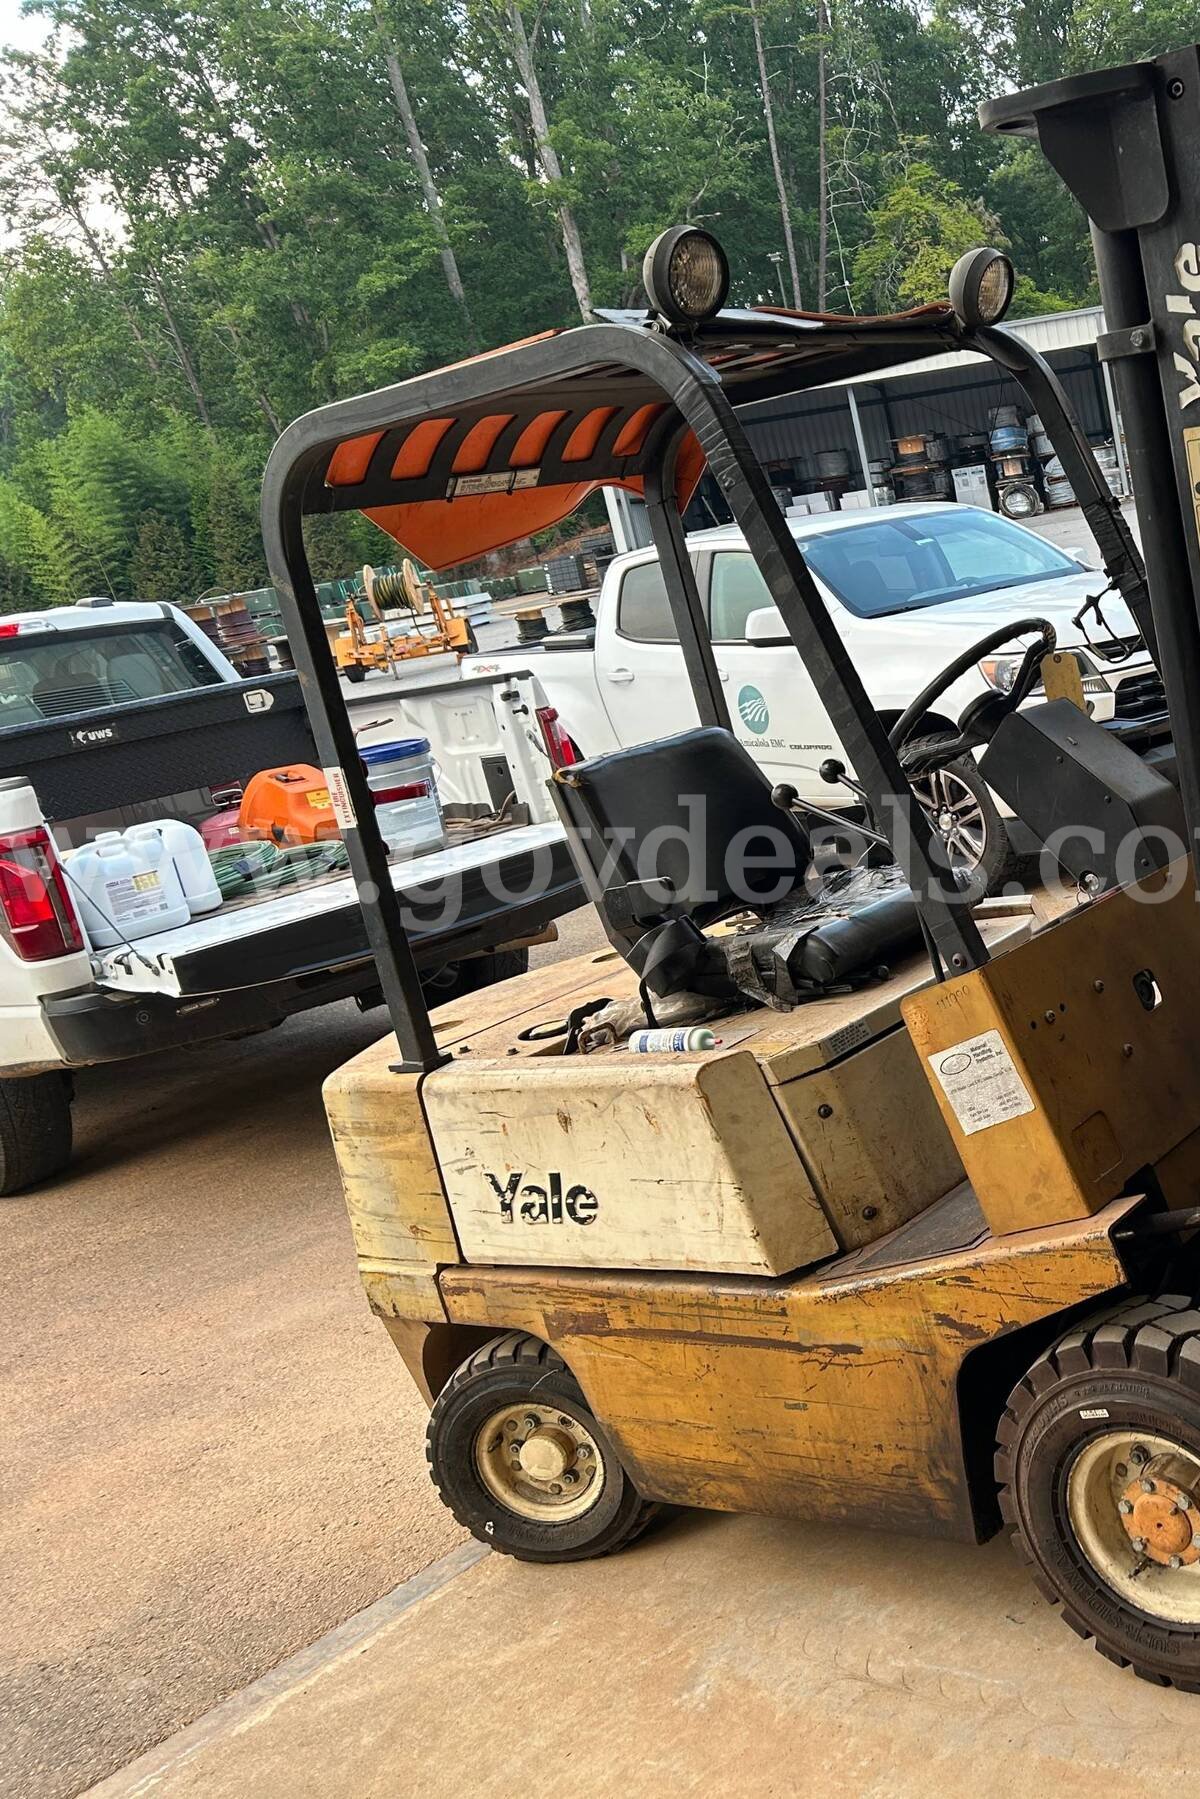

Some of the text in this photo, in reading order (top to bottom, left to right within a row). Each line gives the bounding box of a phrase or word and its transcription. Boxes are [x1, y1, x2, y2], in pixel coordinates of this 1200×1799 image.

[87, 728, 113, 741] UWS
[769, 738, 786, 749] EMC
[484, 1172, 598, 1226] Yale
